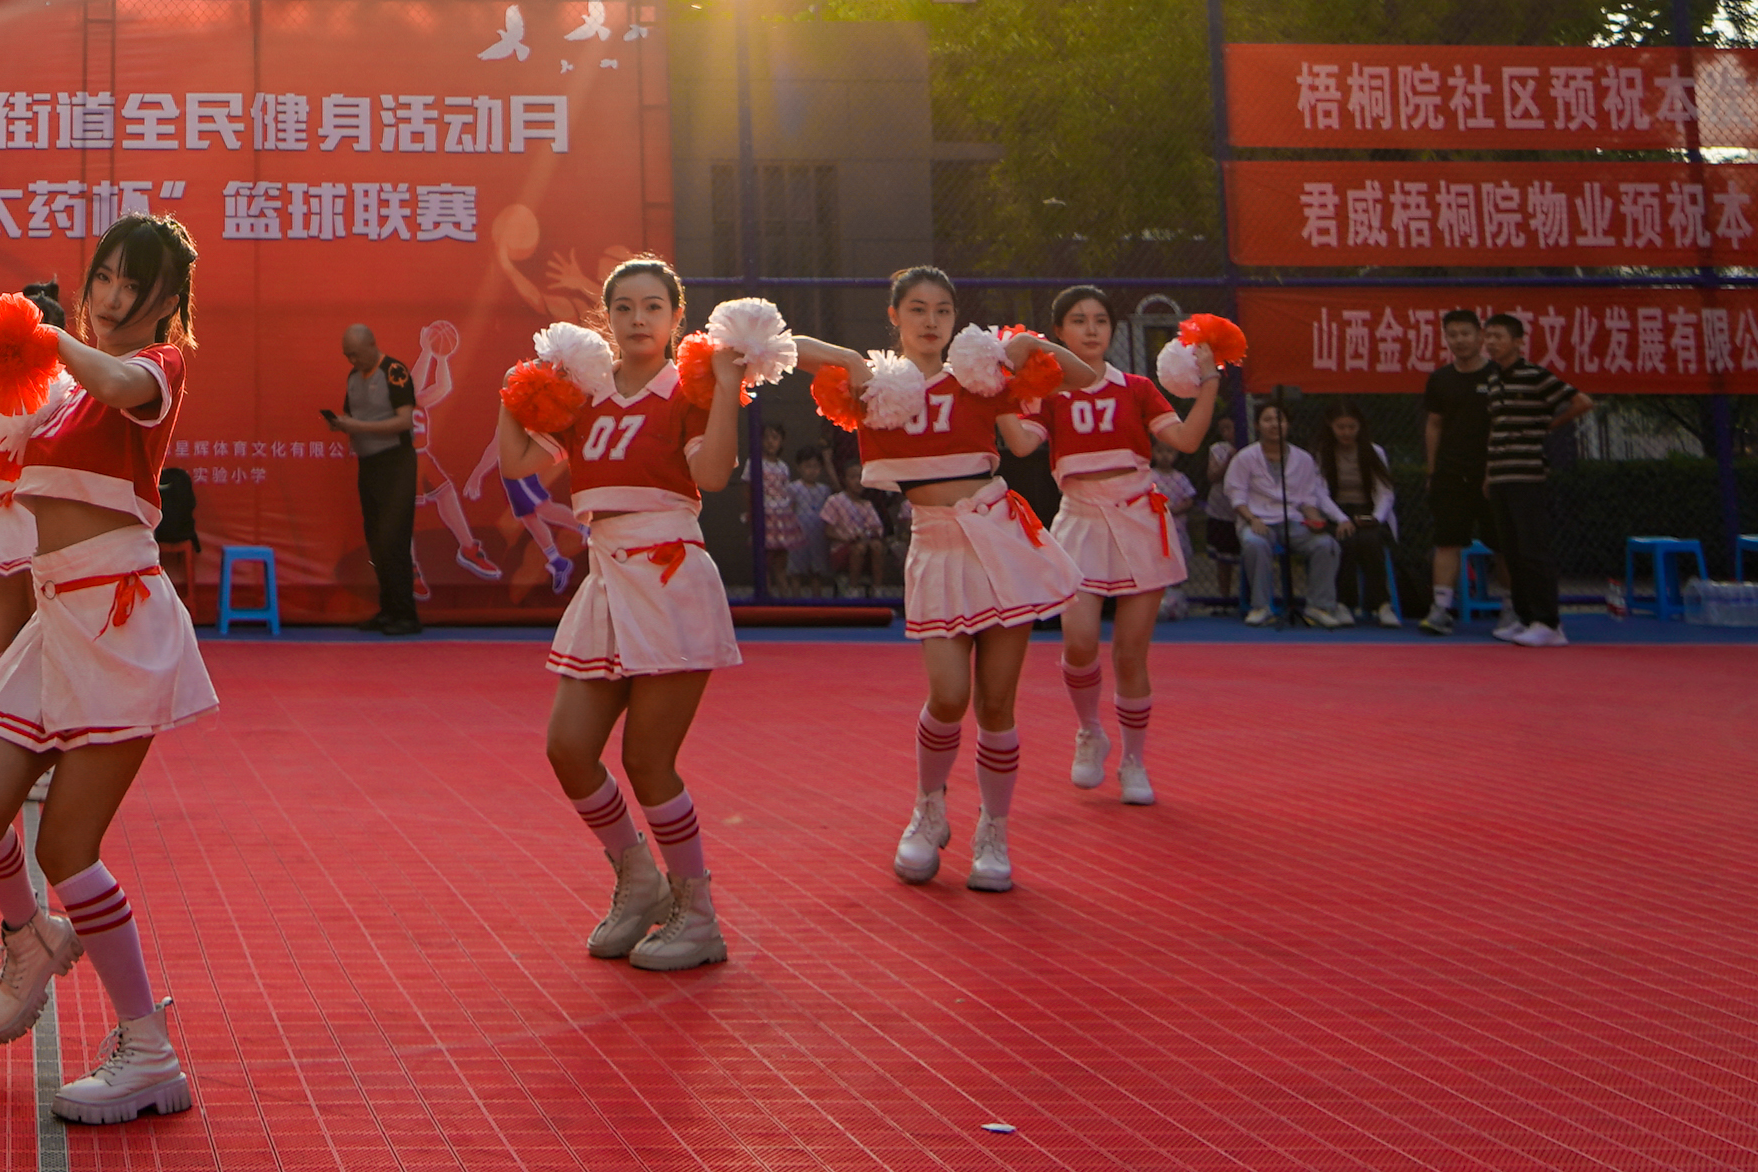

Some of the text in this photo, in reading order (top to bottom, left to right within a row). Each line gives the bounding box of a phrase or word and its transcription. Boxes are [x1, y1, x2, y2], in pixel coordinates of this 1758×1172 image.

[1300, 180, 1753, 250] 君威梧桐院物业预祝本
[1312, 306, 1758, 375] 山西金迈文化发展有限公
[1071, 397, 1117, 434] 07
[167, 440, 357, 458] 星辉体育文化有限公
[582, 414, 646, 461] 07
[186, 467, 267, 484] 实验小学
